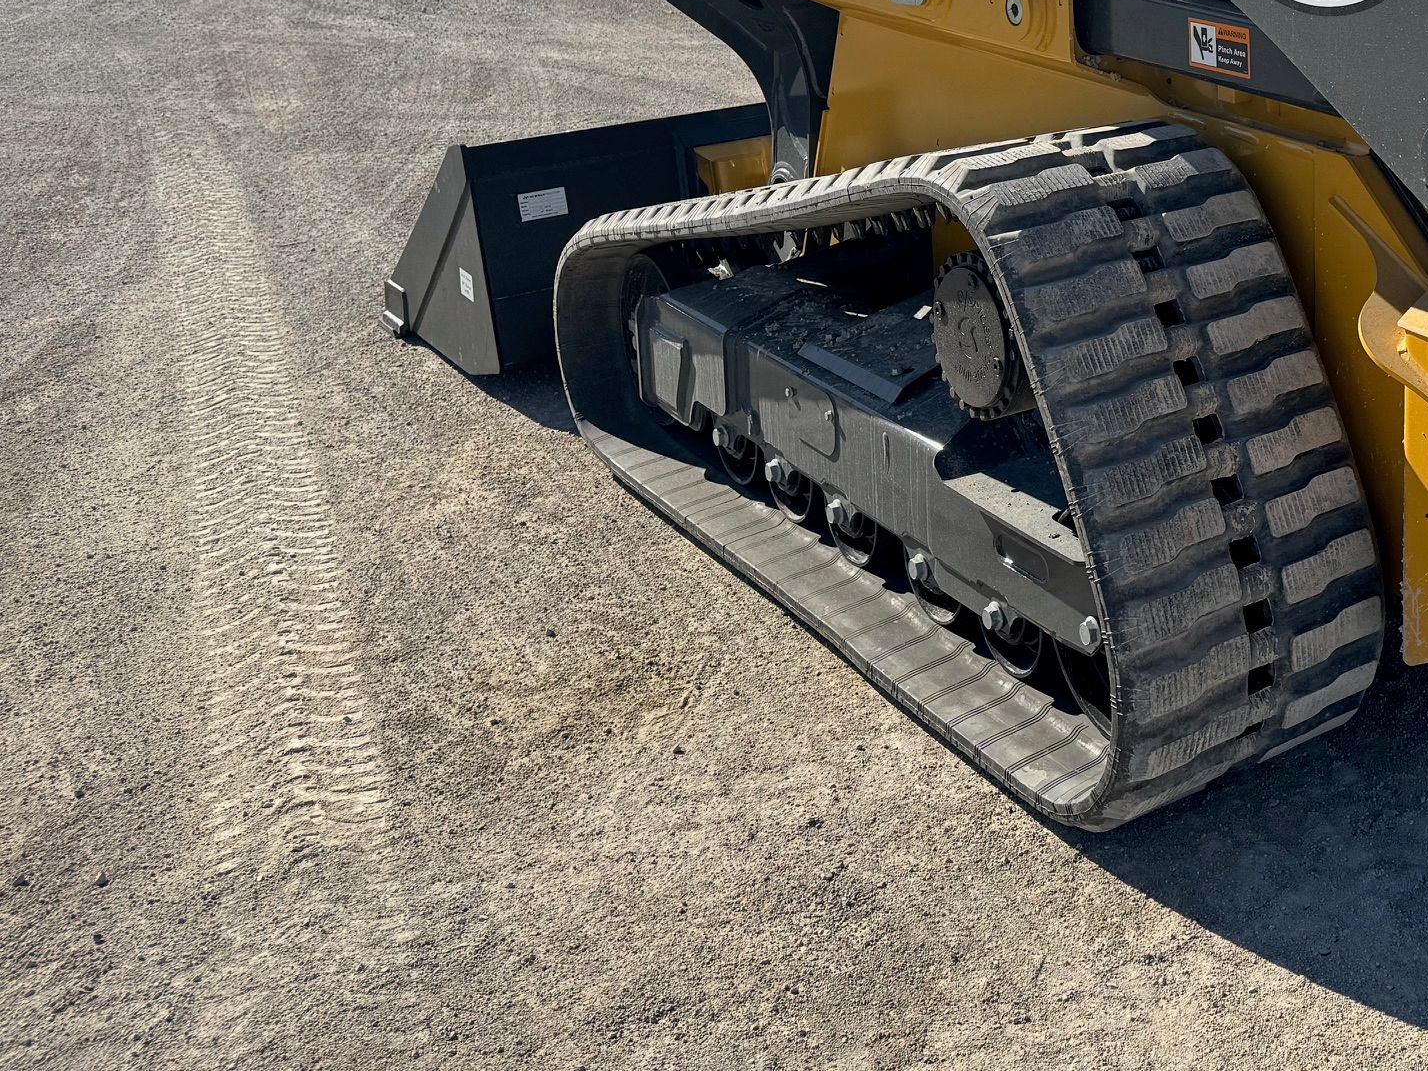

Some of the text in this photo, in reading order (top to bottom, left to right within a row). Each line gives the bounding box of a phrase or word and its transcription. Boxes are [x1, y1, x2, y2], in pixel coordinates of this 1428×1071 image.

[1217, 45, 1246, 58] Pinch Area
[1230, 57, 1242, 68] Away
